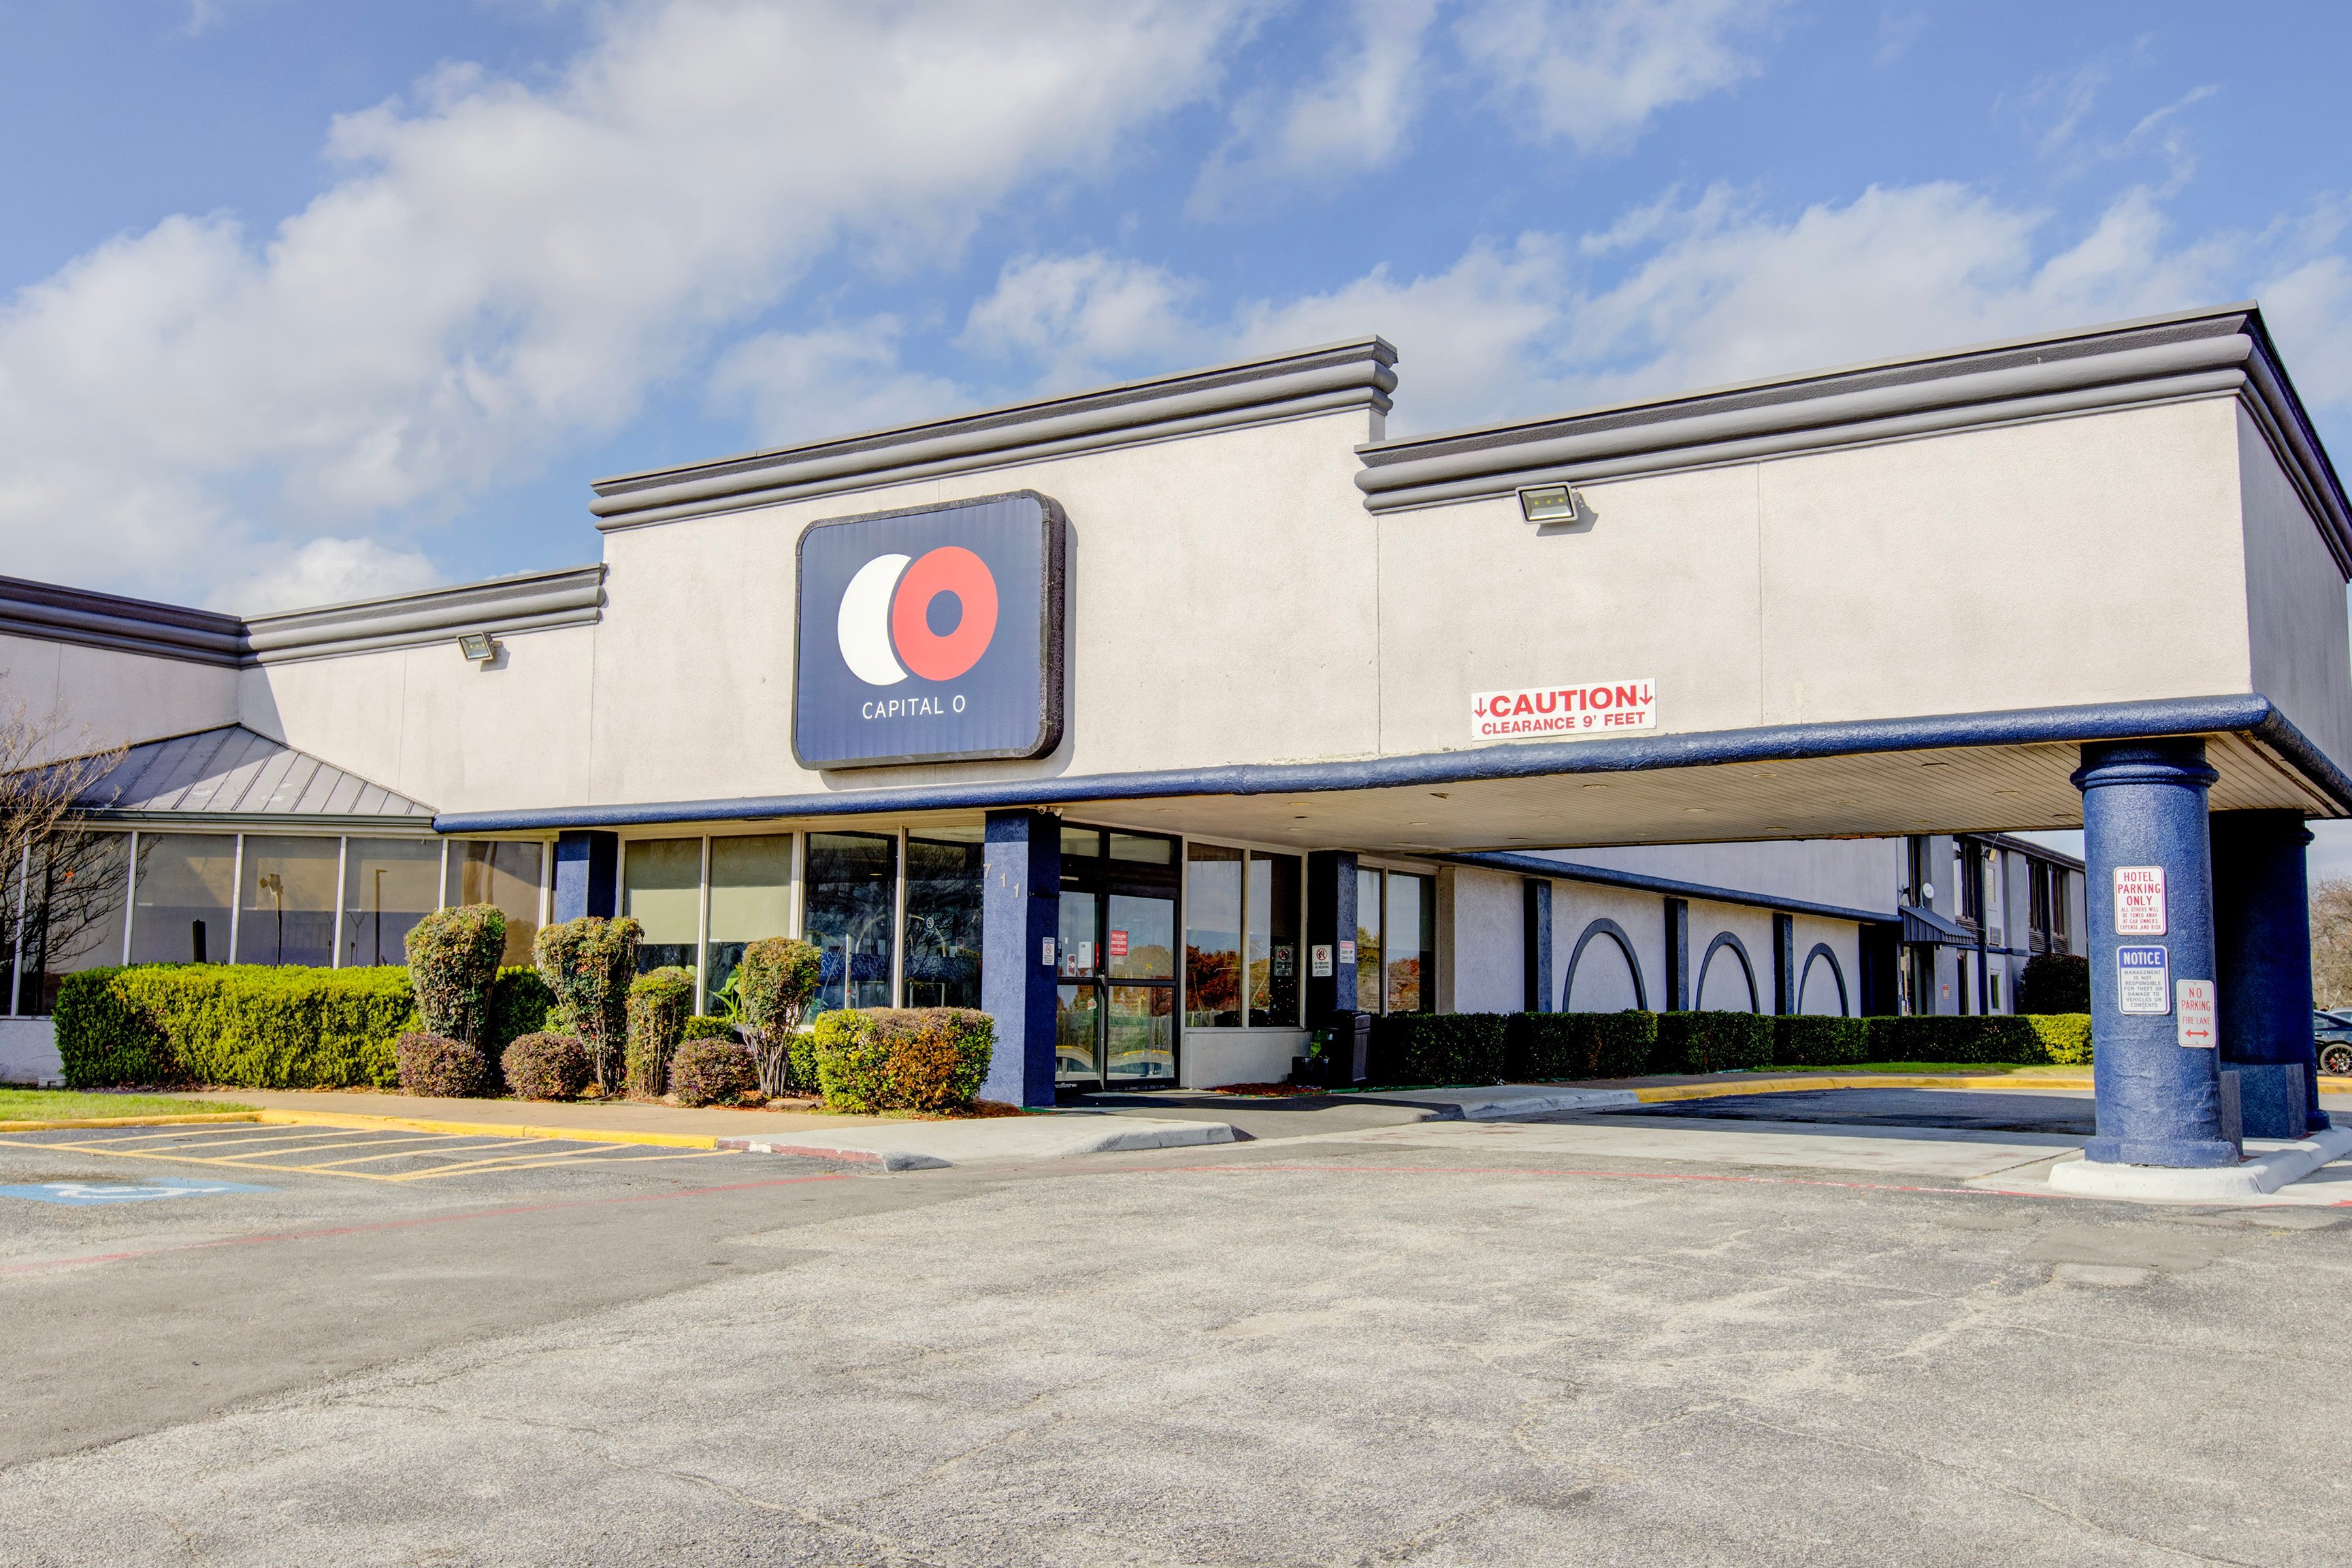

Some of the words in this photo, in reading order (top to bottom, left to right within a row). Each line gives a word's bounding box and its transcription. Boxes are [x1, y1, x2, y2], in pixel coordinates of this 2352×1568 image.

[862, 696, 944, 719] CAPITAL
[952, 694, 966, 713] O
[1489, 685, 1637, 717] CAUTION
[1482, 716, 1575, 735] CLEARANCE
[1582, 715, 1597, 728] 9'
[1604, 711, 1646, 726] FEET
[2123, 871, 2154, 882] HOTEL
[2118, 883, 2161, 894] PARKING
[2127, 896, 2153, 906] ONLY
[2123, 951, 2161, 965] NOTICE
[2189, 987, 2202, 998] NO
[2181, 1000, 2210, 1011] PARKING
[2182, 1016, 2195, 1024] FIRE
[2196, 1017, 2210, 1026] LANE
